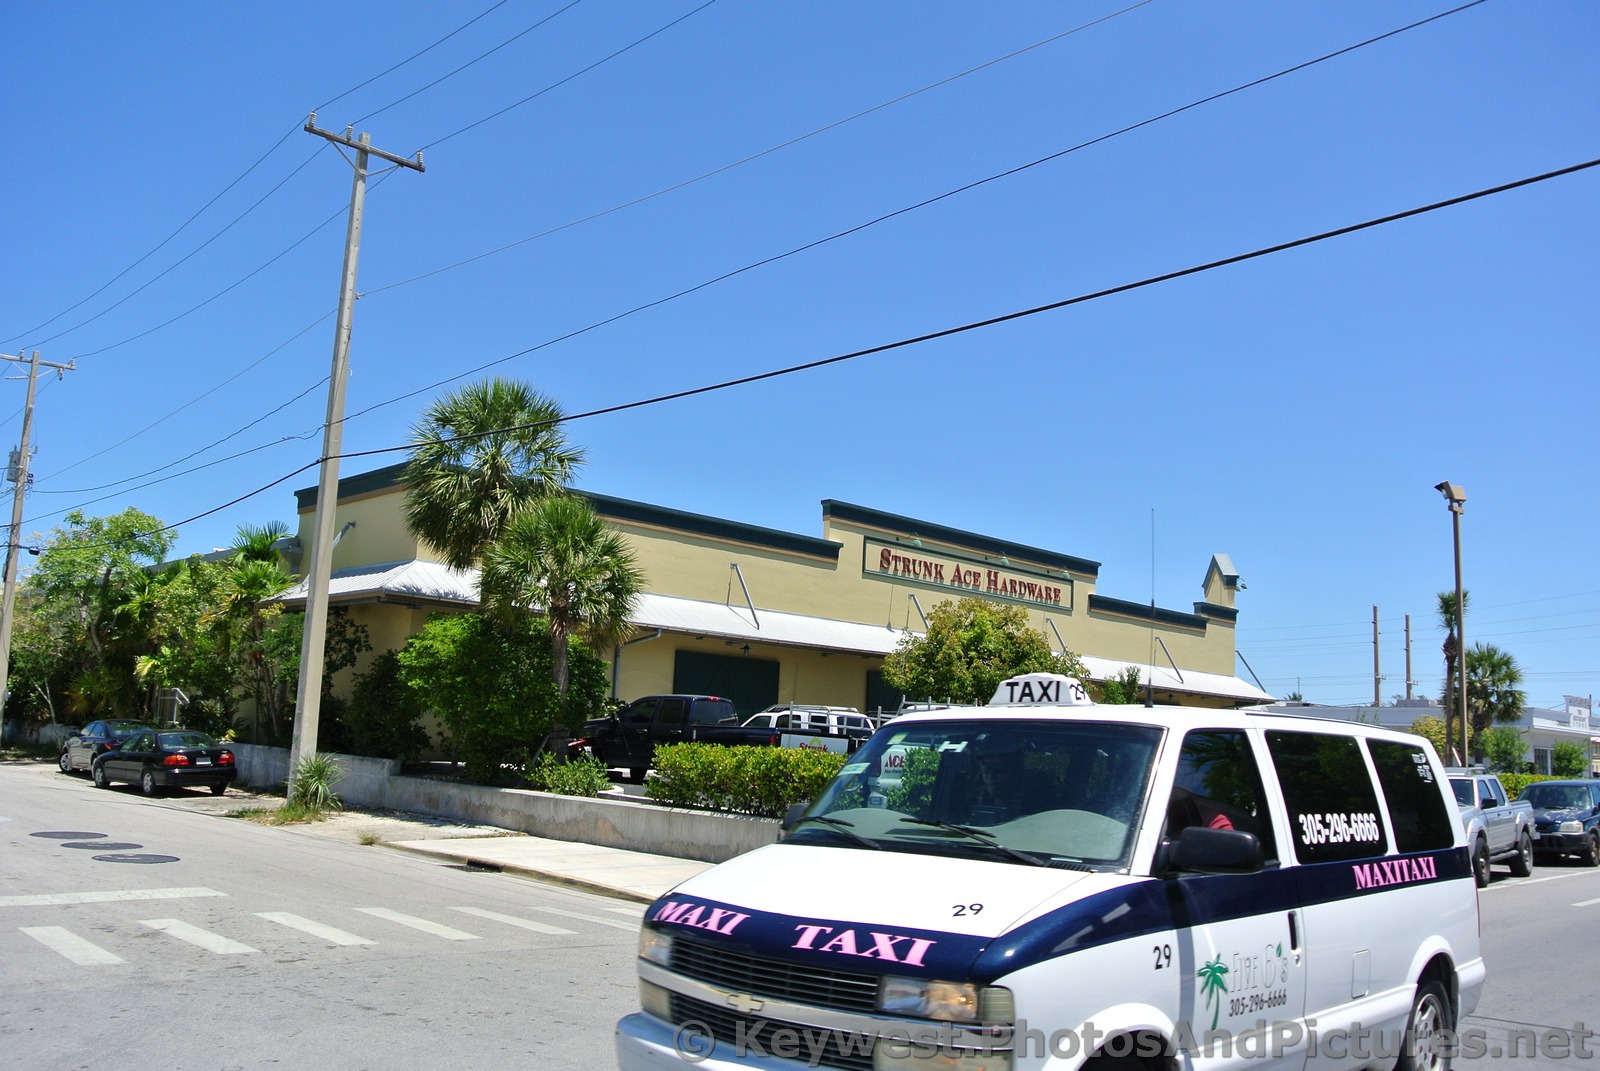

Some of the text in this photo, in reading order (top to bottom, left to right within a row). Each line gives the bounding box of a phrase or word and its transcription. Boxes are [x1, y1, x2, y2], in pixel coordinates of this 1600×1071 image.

[879, 548, 1062, 603] STRUNK ACE HARDWARE
[1005, 680, 1061, 703] TAXI
[1298, 812, 1380, 845] 305-296-6666
[1352, 856, 1437, 890] MAXITAXI
[952, 903, 984, 917] 29
[651, 901, 938, 967] MAXI TAXI
[1153, 943, 1172, 970] 29
[1228, 988, 1288, 1018] 305-296-6666
